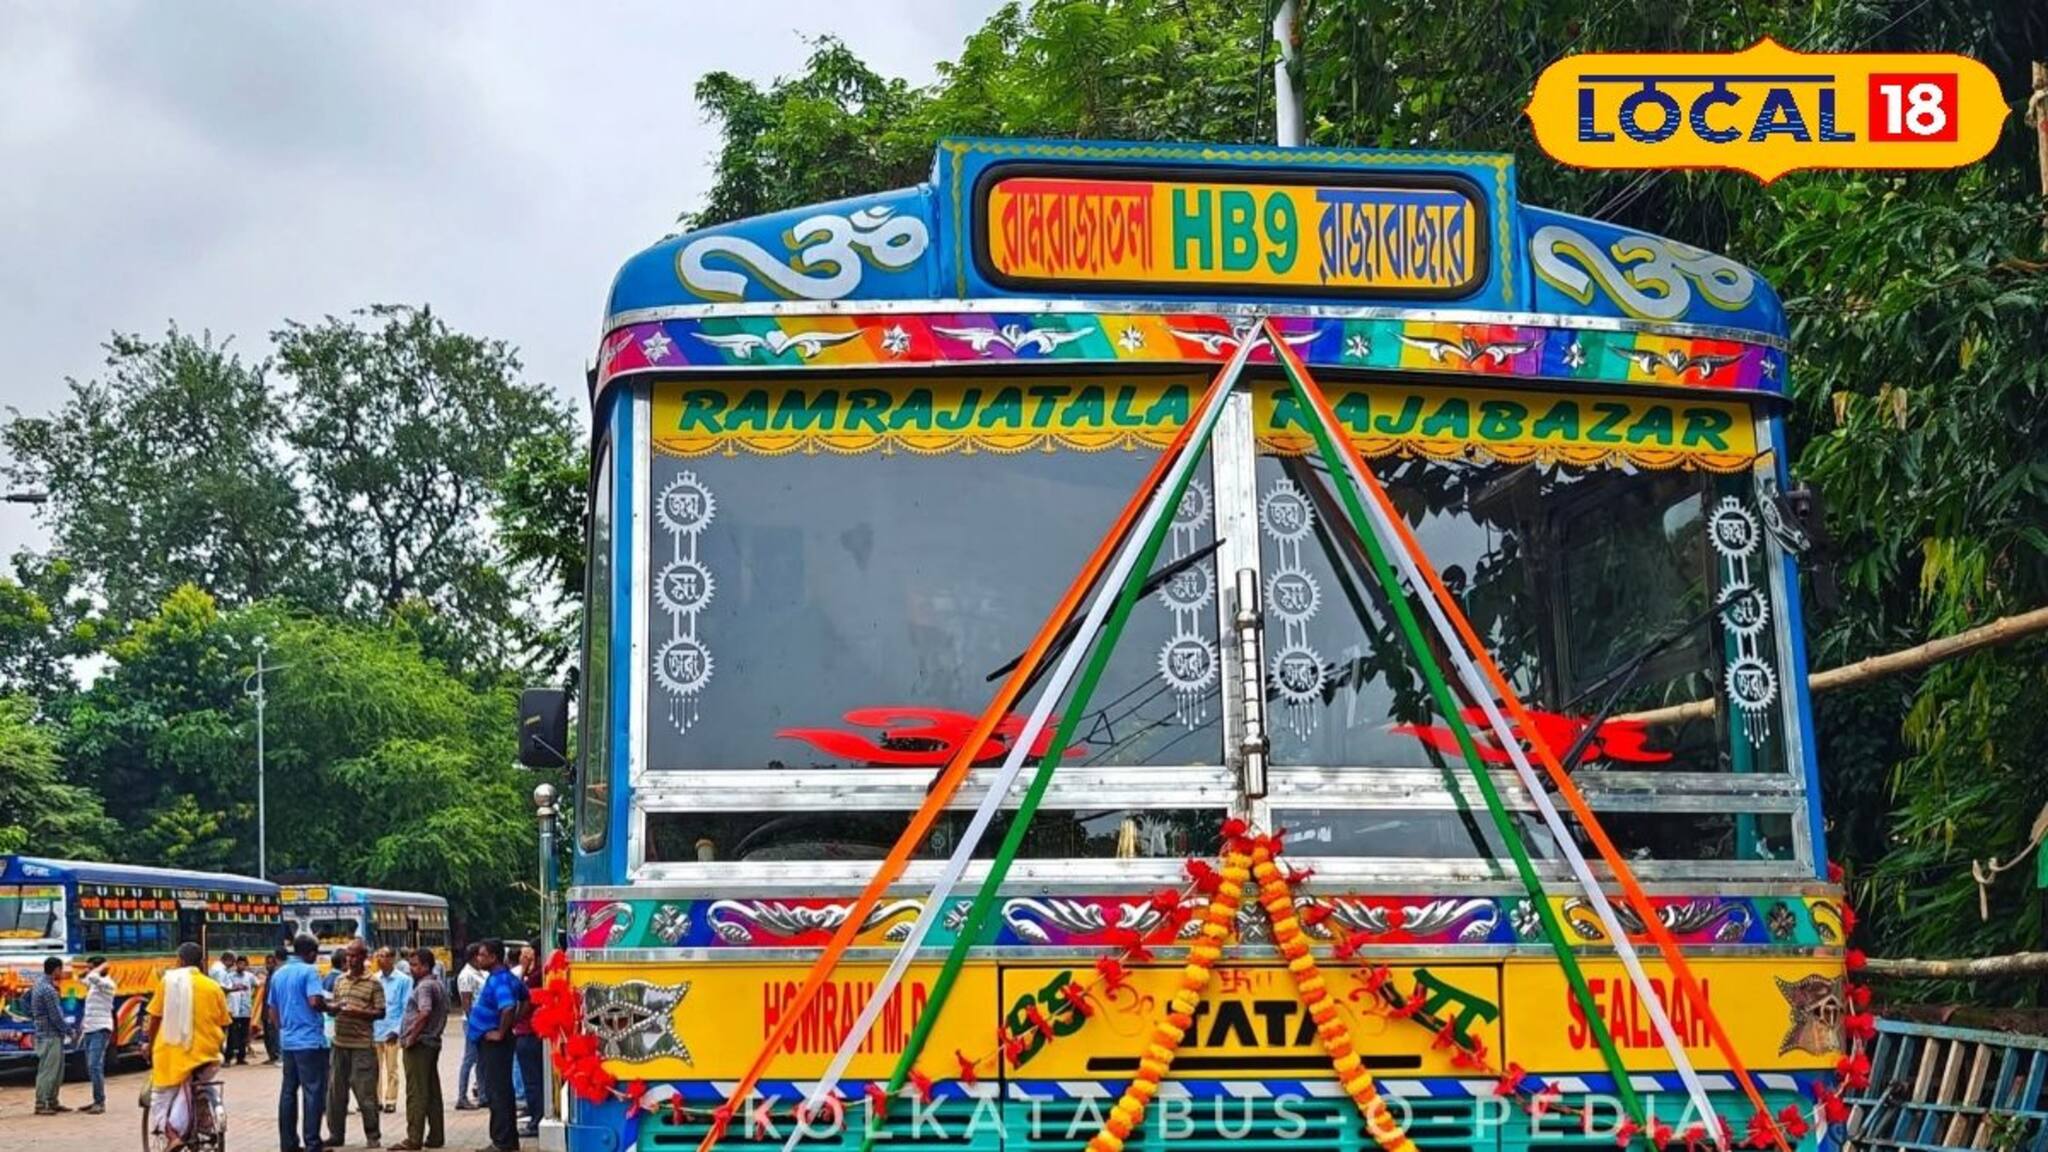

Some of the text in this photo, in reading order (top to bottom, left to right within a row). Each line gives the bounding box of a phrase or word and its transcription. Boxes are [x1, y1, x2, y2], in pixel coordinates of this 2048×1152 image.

[998, 180, 1153, 276] রামরাজাতলা
[1171, 188, 1299, 275] HB9
[1316, 189, 1466, 286] রাজাবাজার
[678, 384, 1190, 433] RAMRAJATALA
[764, 981, 874, 1055] HOWRAH
